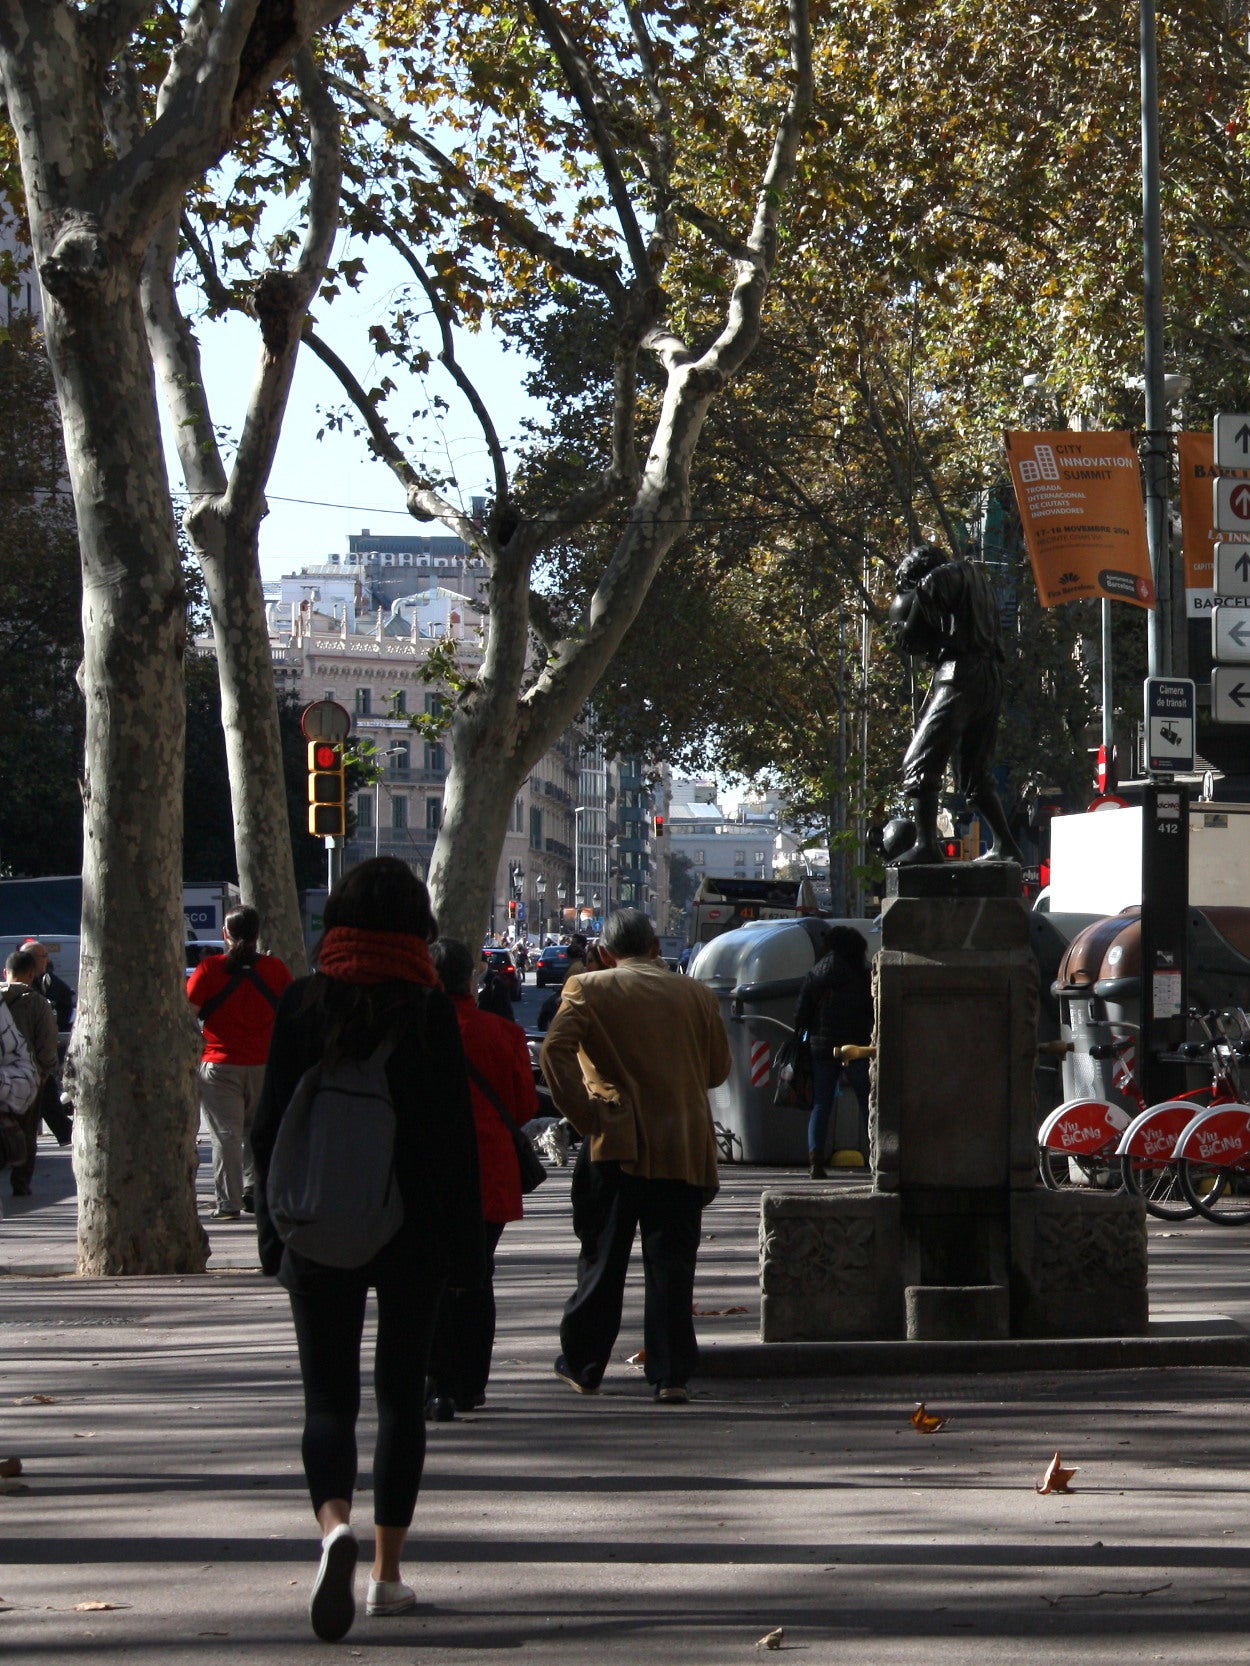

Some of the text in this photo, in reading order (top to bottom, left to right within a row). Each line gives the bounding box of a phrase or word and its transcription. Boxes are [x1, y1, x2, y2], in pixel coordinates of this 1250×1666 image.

[1056, 444, 1082, 455] CITY
[1060, 457, 1133, 469] INNOVATION
[1064, 470, 1112, 480] SUMMIT
[1026, 485, 1062, 494] TROBADA
[1028, 492, 1087, 502] INTERNACIONAL
[1030, 500, 1070, 511] DE CIUTATS
[1031, 507, 1084, 519] INNOVADORES
[1064, 525, 1111, 533] NOVEMBRE
[1157, 698, 1165, 707] de
[1158, 823, 1179, 834] 412
[1058, 1120, 1079, 1134] Viu
[1140, 1128, 1163, 1142] Viu
[1195, 1130, 1218, 1145] Viu
[1144, 1133, 1179, 1155] BiCiN
